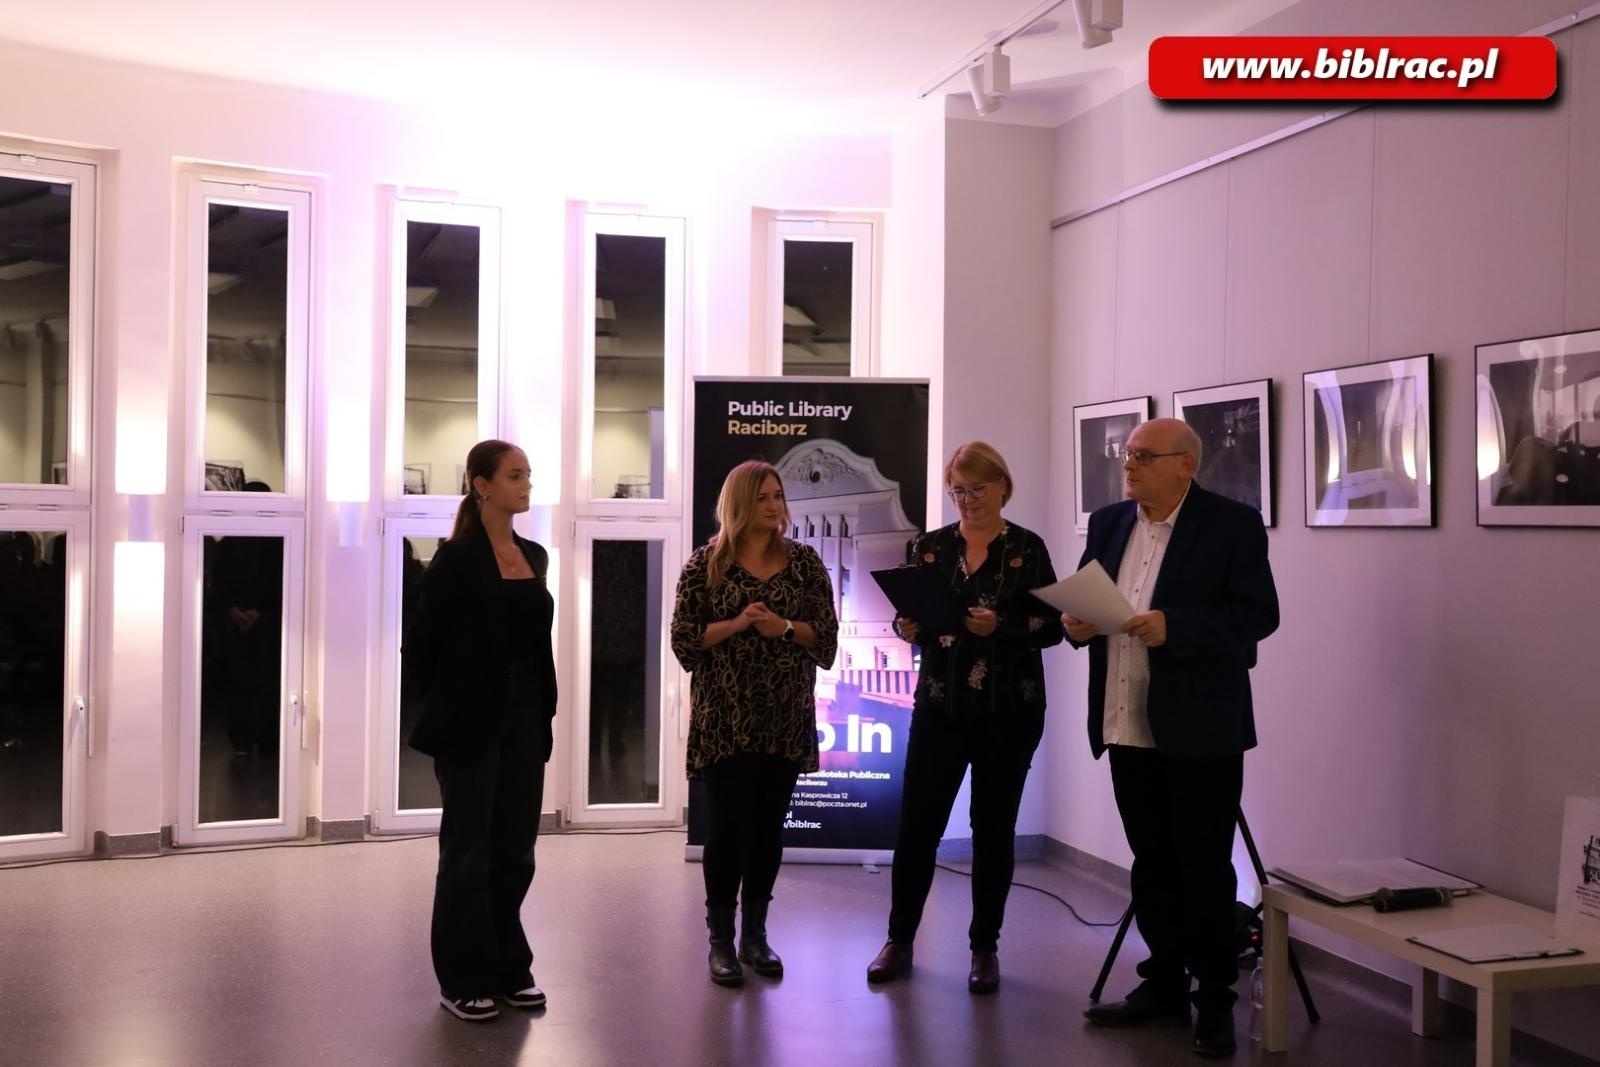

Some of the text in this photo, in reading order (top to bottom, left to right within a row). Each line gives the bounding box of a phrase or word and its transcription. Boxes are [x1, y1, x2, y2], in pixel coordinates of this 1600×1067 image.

[728, 401, 853, 421] Public Library
[728, 420, 807, 436] Raciborz
[847, 714, 892, 753] In
[849, 771, 891, 780] Publiczna
[795, 800, 867, 808] biblrac@poczta.onet.pl
